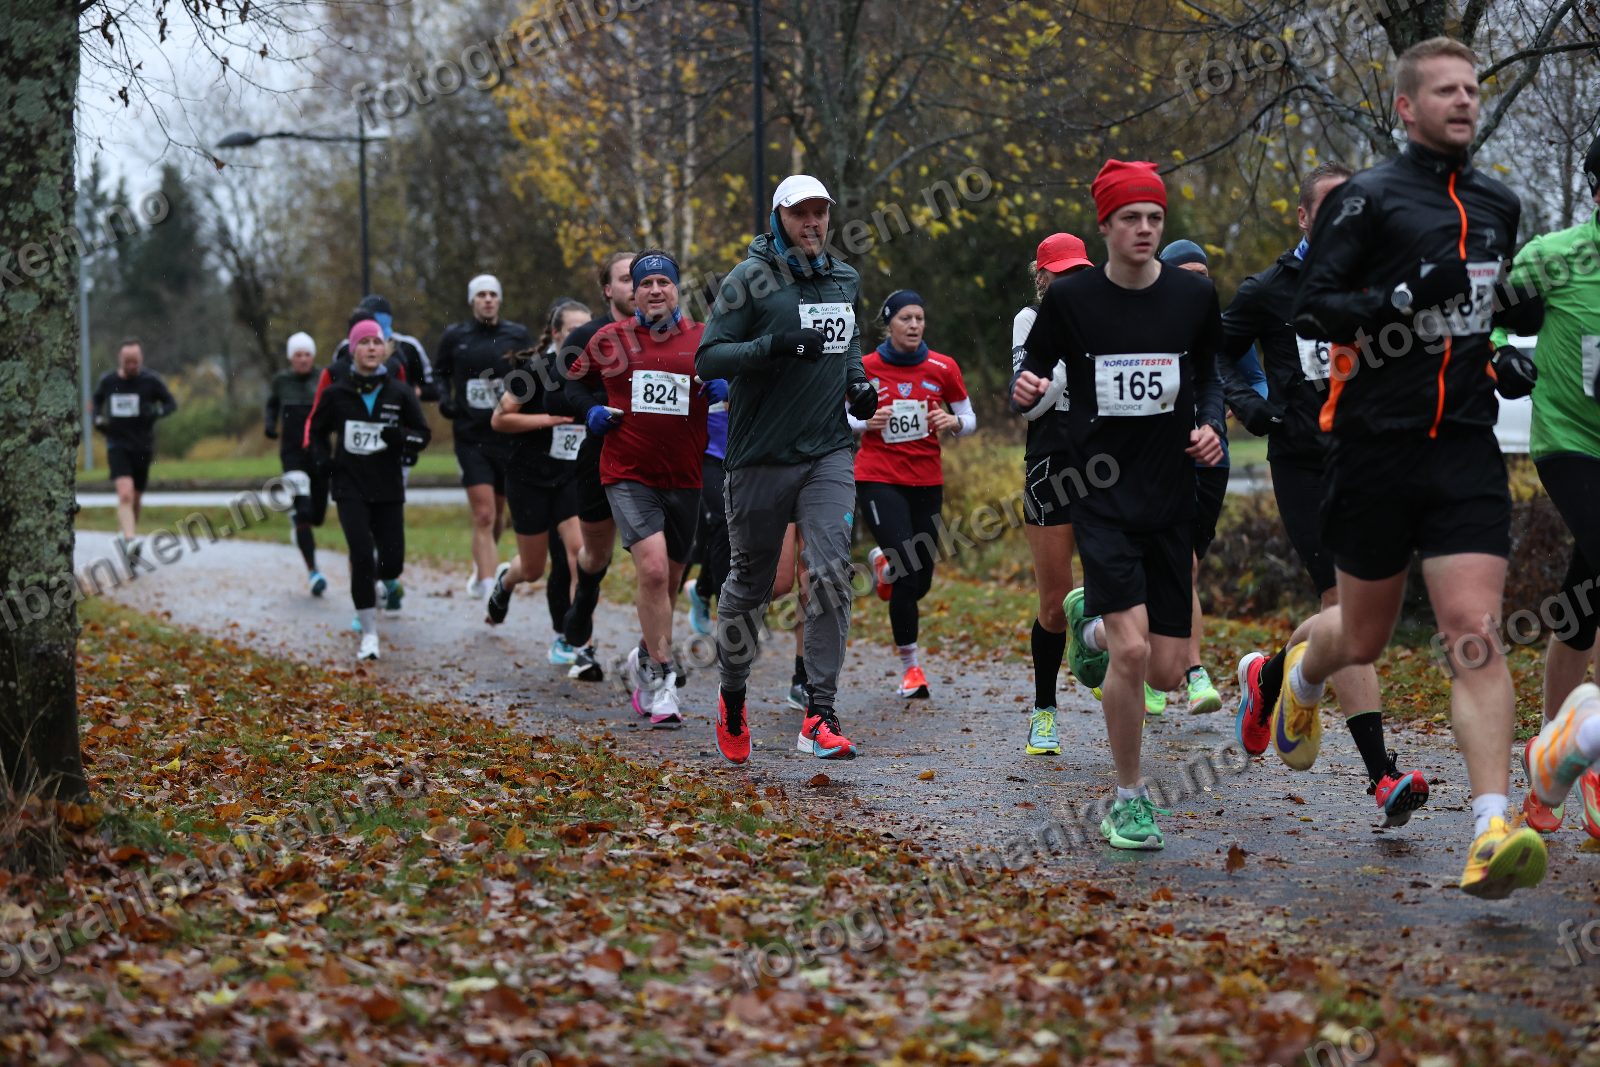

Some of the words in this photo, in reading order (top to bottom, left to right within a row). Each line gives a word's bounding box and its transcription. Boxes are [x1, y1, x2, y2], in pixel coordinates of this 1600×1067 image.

[1103, 359, 1173, 367] NORGESTESTEN
[642, 382, 679, 406] 824
[1113, 371, 1163, 401] 165
[889, 413, 920, 434] 664
